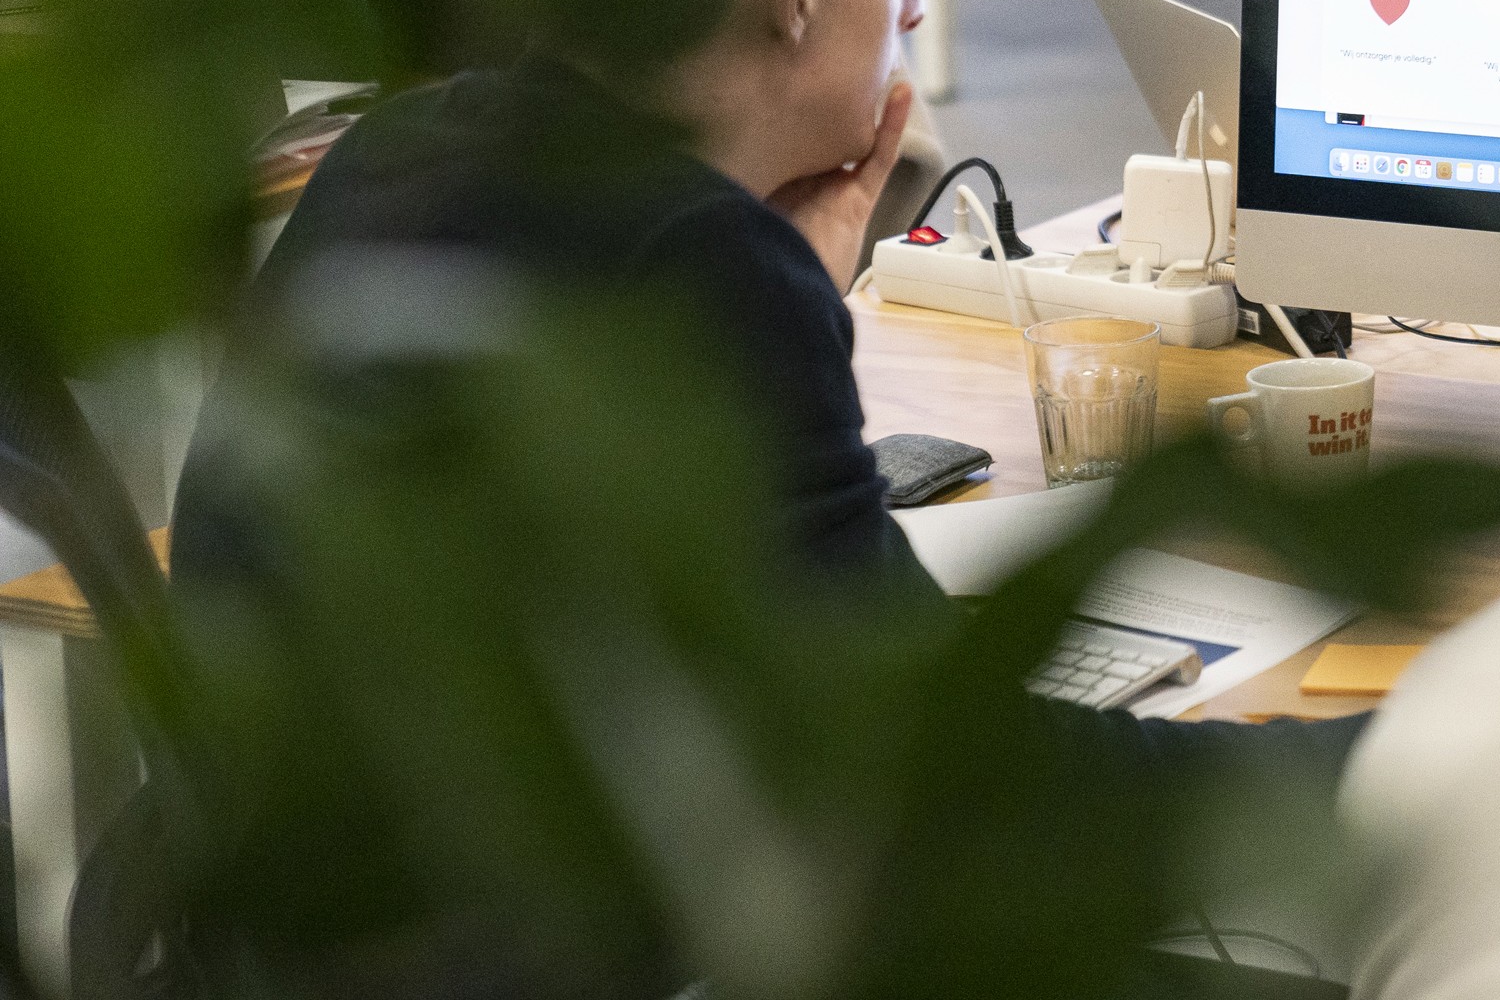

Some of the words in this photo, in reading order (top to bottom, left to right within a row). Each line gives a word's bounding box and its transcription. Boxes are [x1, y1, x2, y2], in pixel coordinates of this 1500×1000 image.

[1355, 51, 1393, 62] ontzorgen
[1394, 53, 1401, 63] je
[1308, 414, 1336, 435] In
[1340, 411, 1357, 432] it
[1308, 435, 1352, 457] win
